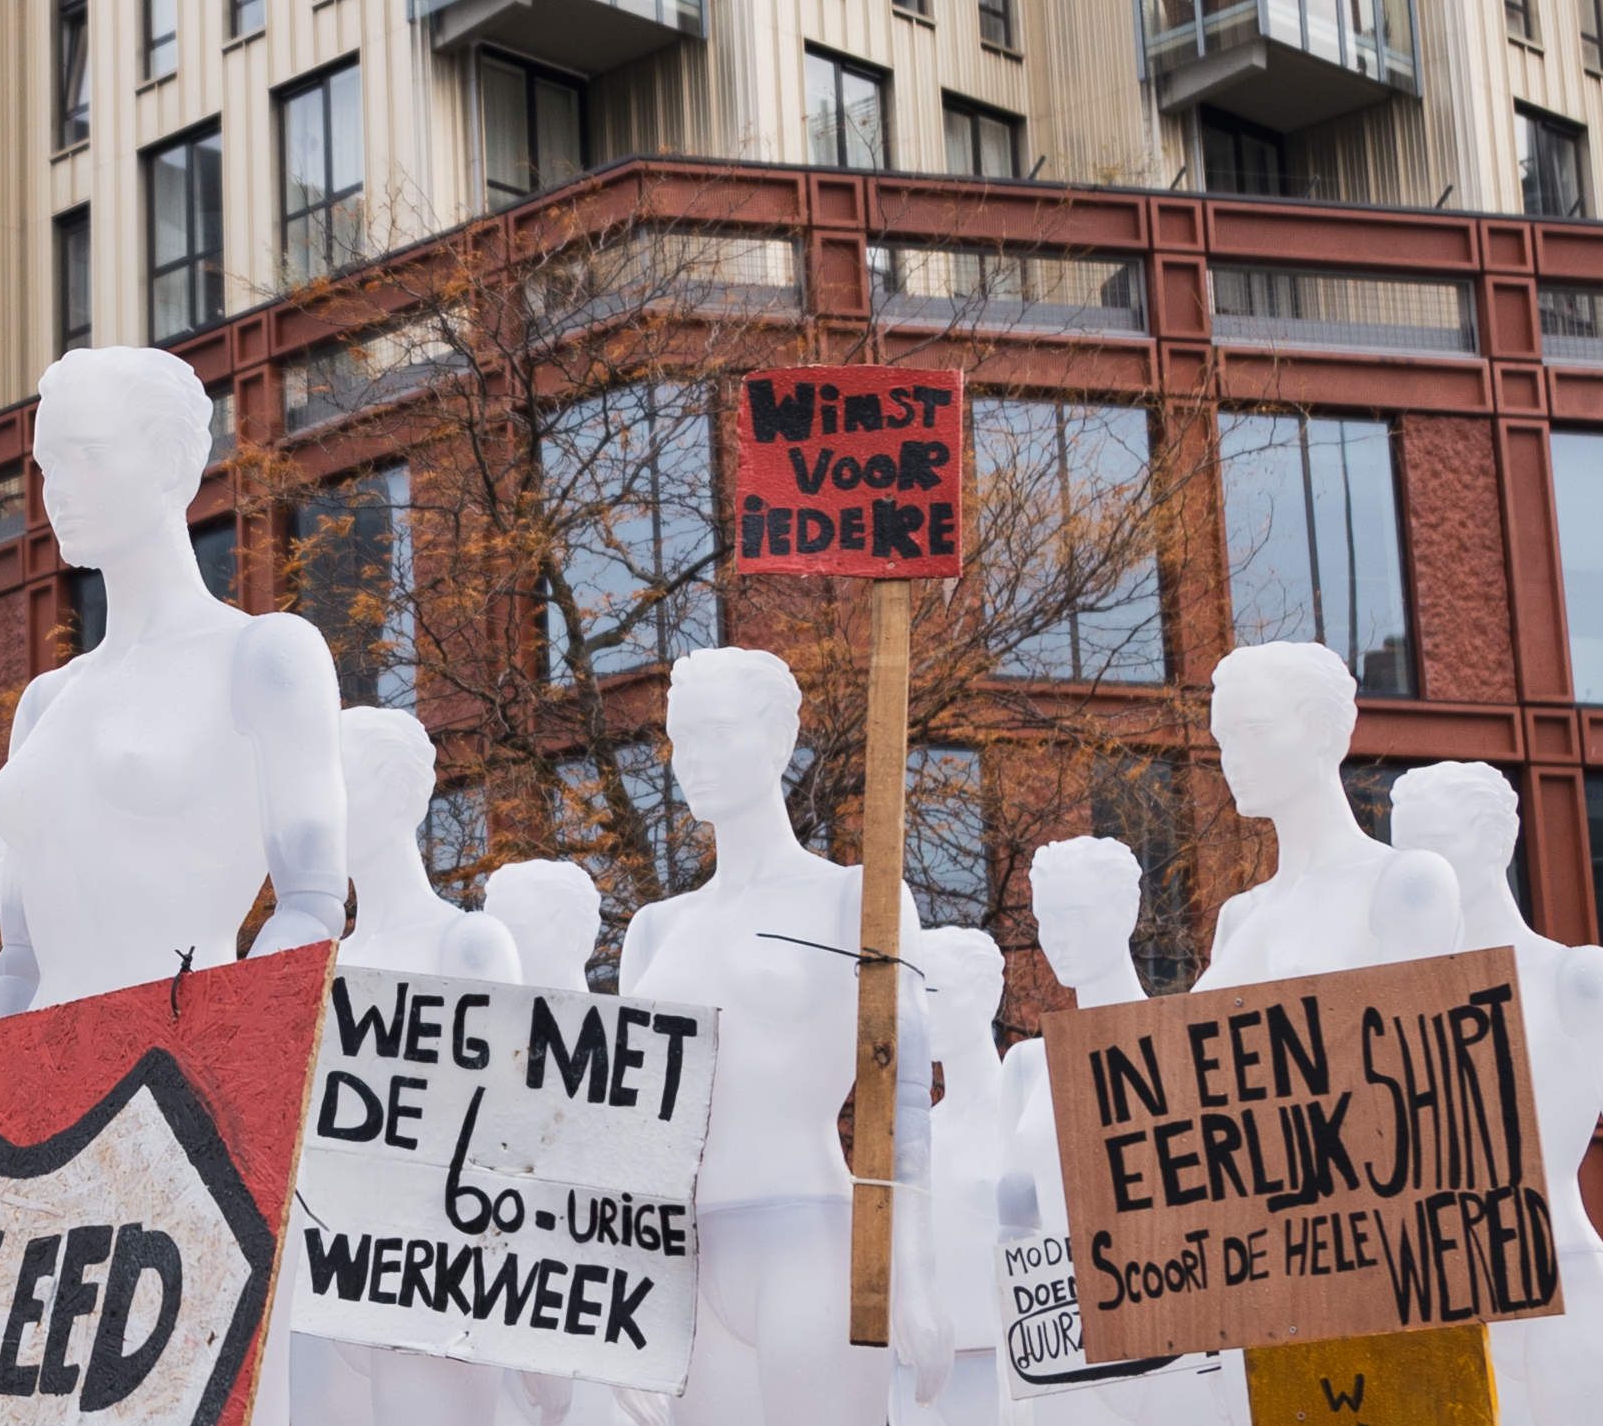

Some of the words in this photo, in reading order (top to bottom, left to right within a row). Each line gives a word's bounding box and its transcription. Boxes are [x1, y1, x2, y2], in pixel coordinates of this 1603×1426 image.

[788, 440, 950, 495] VOOR
[317, 1071, 428, 1150] DE
[332, 976, 490, 1069] WEG
[526, 996, 697, 1121] MET
[1089, 1035, 1168, 1127] IN
[1188, 995, 1329, 1107] EEN
[1104, 1091, 1360, 1214] EERLIJK
[1362, 983, 1523, 1199] SHIRT
[304, 1228, 654, 1350] WERKWEEK
[1223, 1228, 1270, 1286] DE
[1285, 1211, 1378, 1277] HELE
[1374, 1186, 1558, 1326] WERELD
